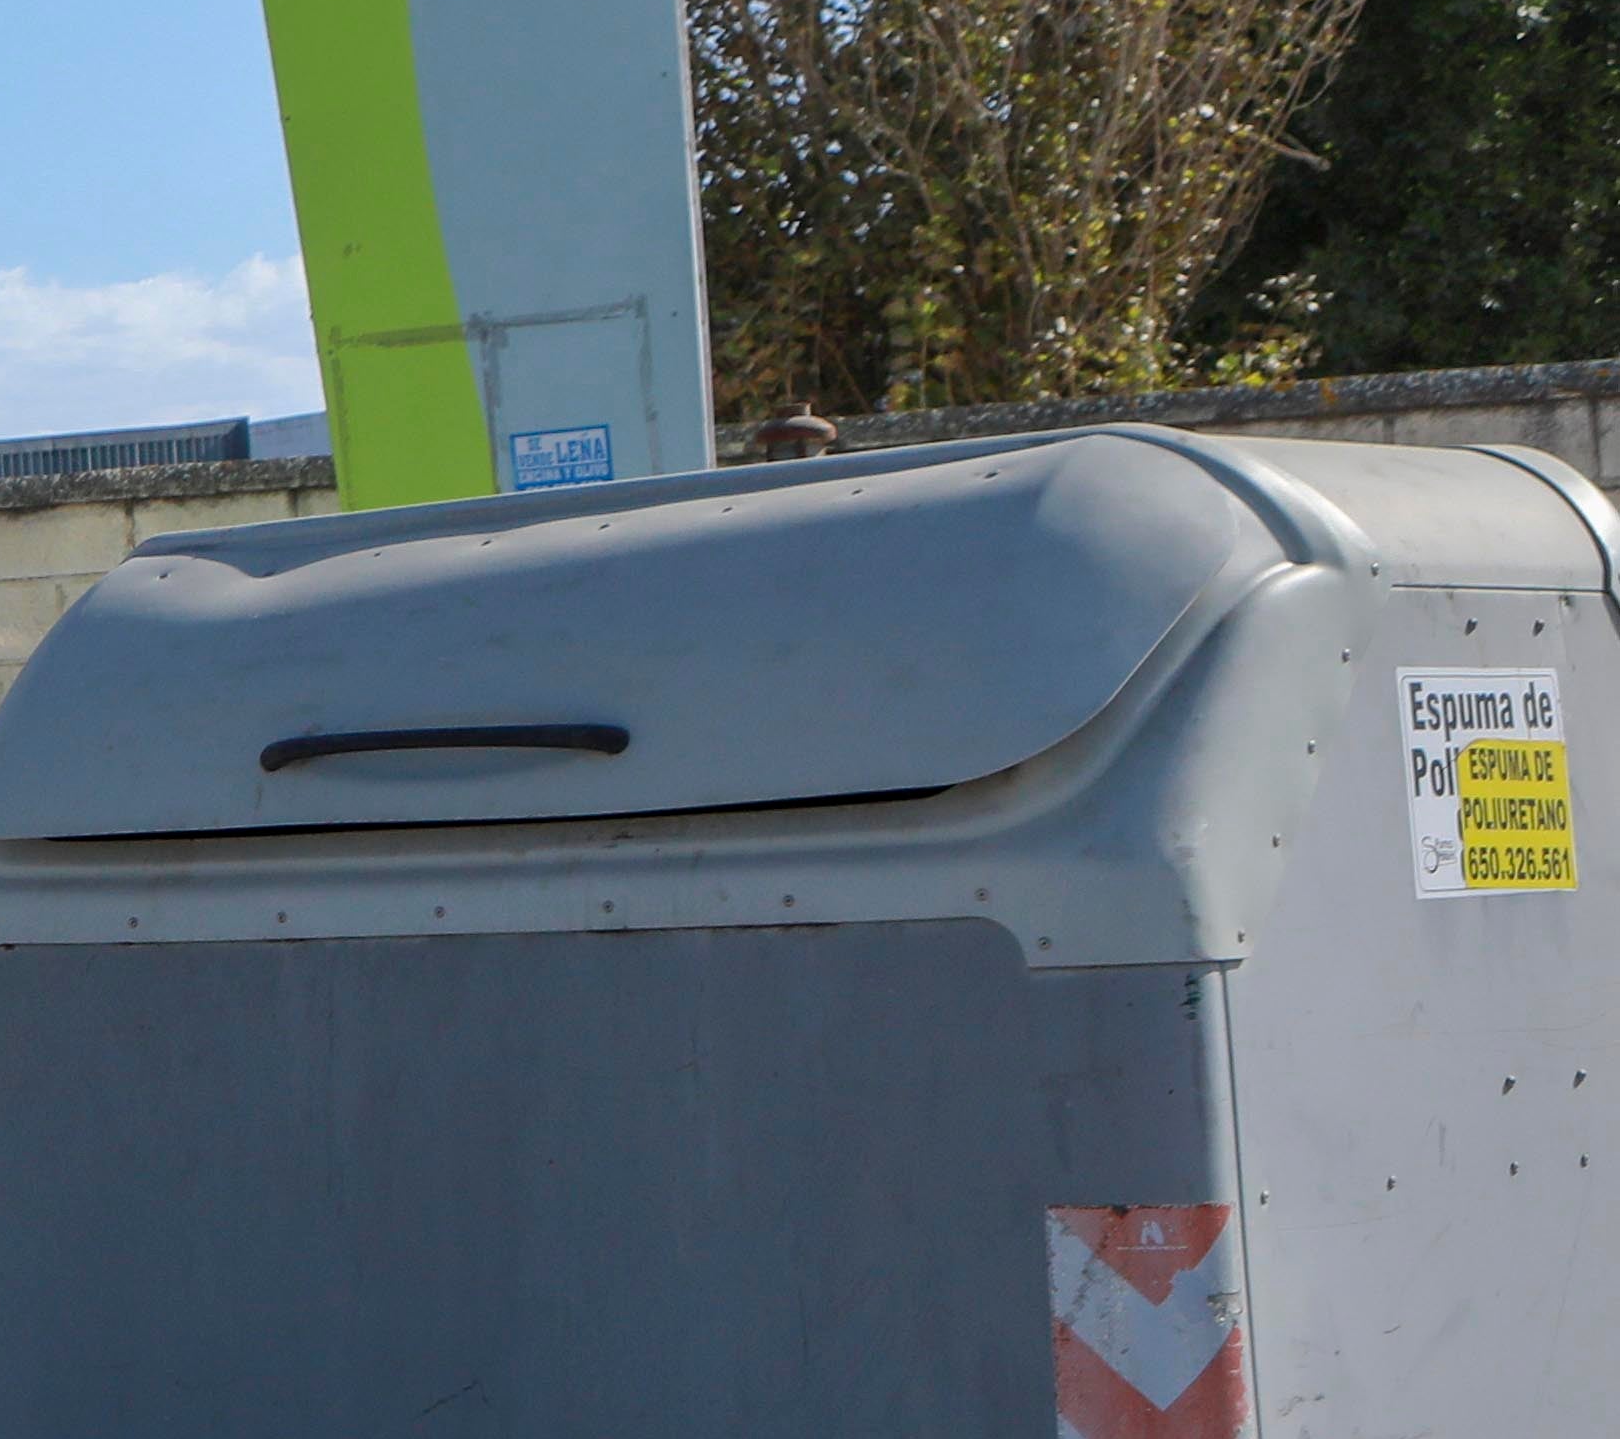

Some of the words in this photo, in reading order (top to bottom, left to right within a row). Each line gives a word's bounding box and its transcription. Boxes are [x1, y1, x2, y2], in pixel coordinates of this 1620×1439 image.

[555, 431, 606, 463] LEÑA
[1408, 681, 1515, 741] Espuma
[1522, 681, 1553, 730] de
[1469, 748, 1530, 781] ESPUMA
[1533, 750, 1554, 782] DE
[1462, 797, 1567, 831] POLIURETANO
[1468, 846, 1571, 880] 650.326.561
